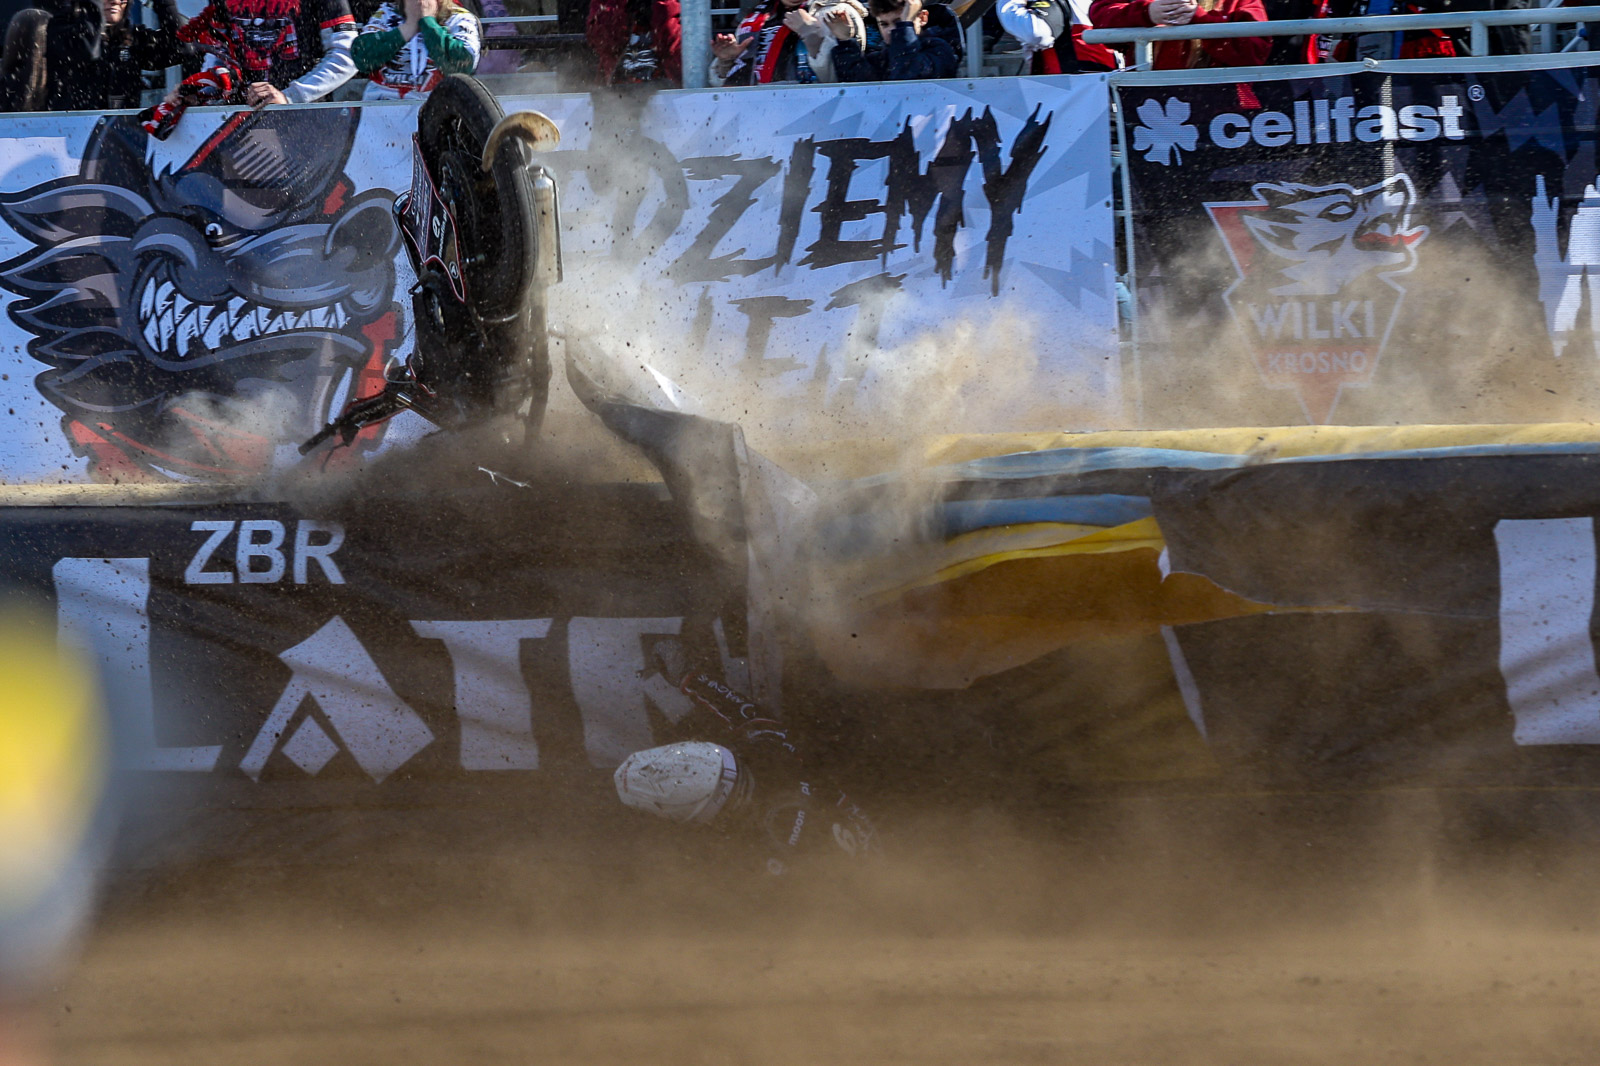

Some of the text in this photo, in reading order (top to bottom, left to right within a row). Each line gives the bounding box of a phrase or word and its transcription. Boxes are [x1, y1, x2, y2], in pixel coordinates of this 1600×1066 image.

[1209, 95, 1465, 149] cellfast
[1250, 300, 1374, 340] WILKI
[1267, 349, 1368, 375] KROSNO
[184, 519, 346, 585] ZBR
